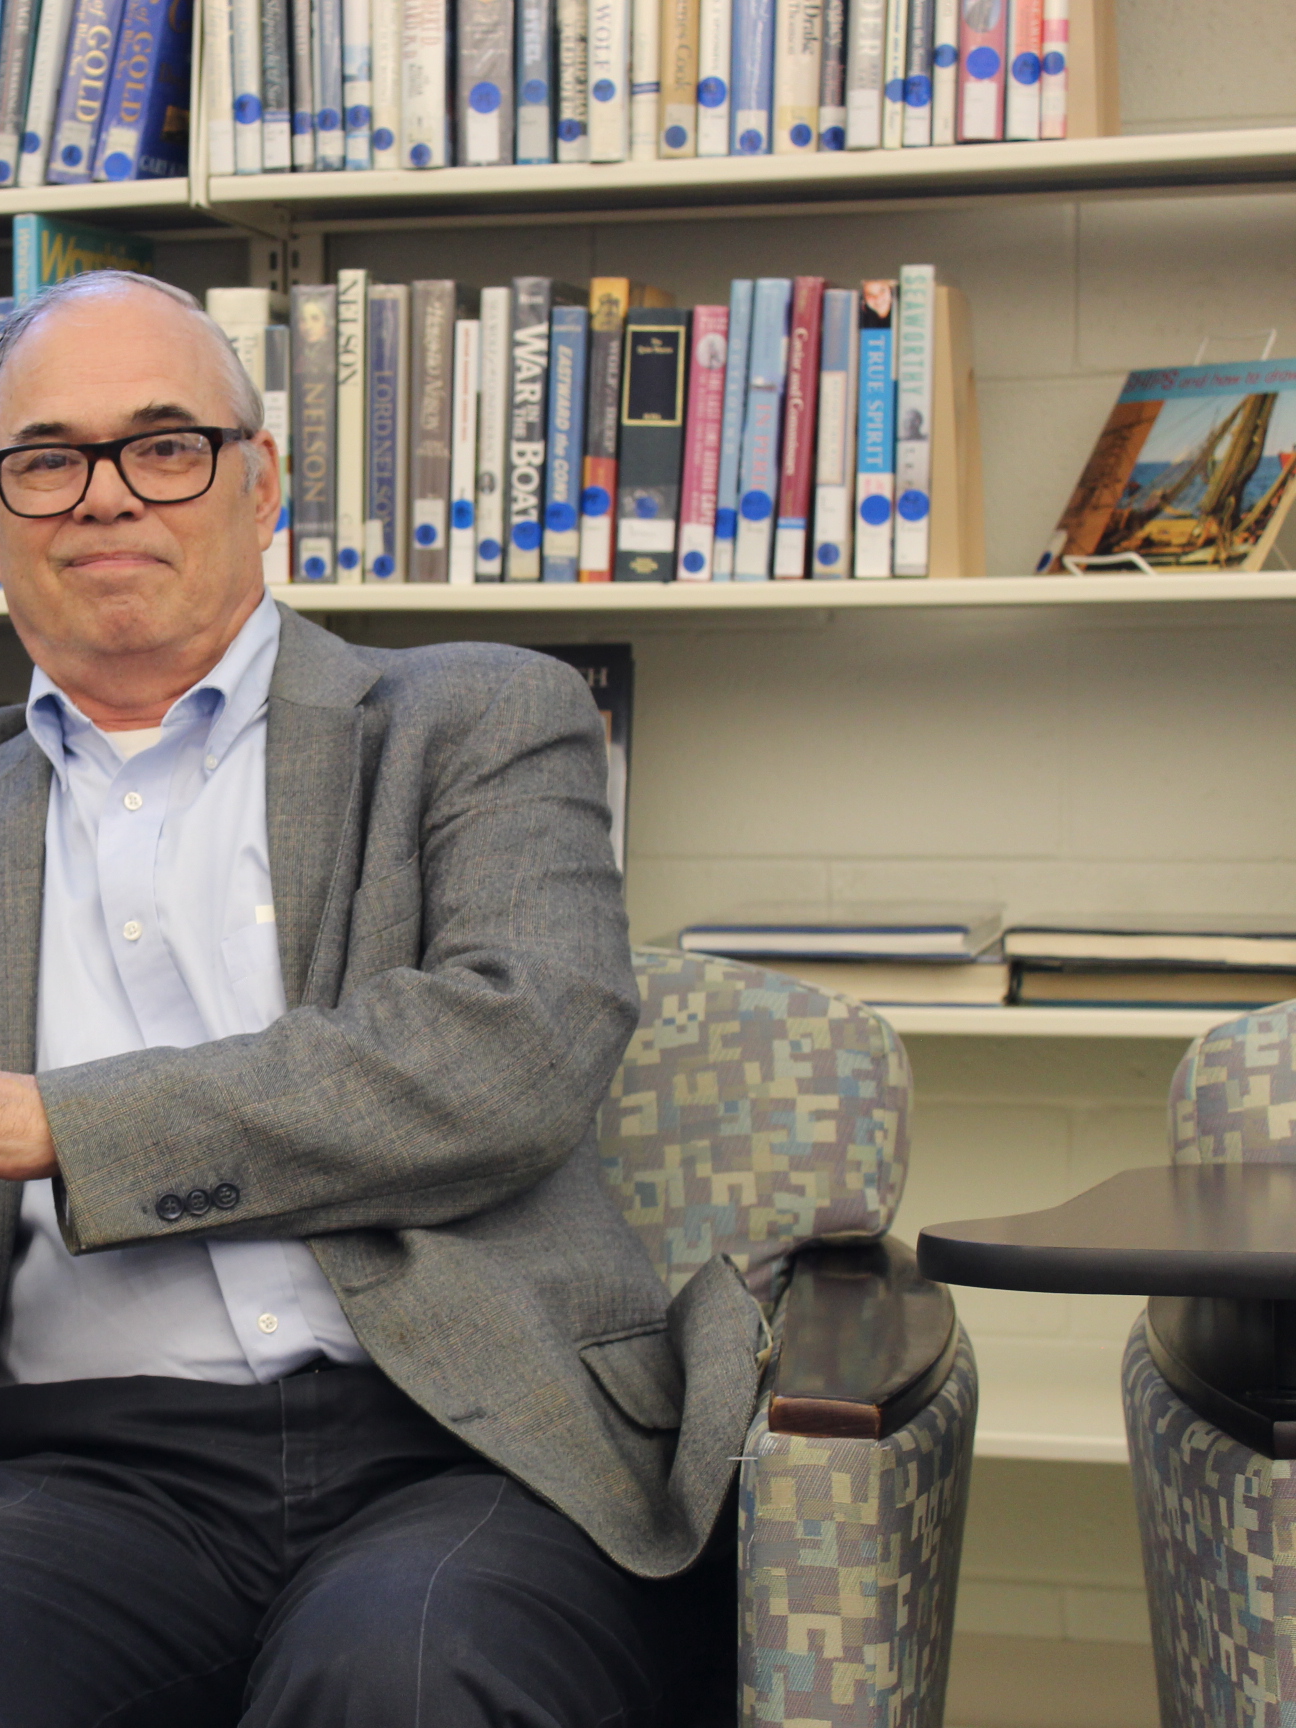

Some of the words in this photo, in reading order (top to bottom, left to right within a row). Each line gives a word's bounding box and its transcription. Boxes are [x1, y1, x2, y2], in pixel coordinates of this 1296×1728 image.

[133, 8, 151, 23] of
[523, 8, 542, 66] STEEL
[593, 4, 611, 72] WOLF
[673, 0, 692, 39] ames
[801, 4, 821, 56] Drake
[68, 54, 82, 77] Sea
[74, 24, 113, 123] GOLD
[119, 31, 154, 123] GOLD
[673, 44, 694, 92] Cook
[338, 278, 360, 387] NELSON
[789, 327, 810, 370] Caviar
[902, 274, 928, 396] SEAWORTHY
[513, 322, 549, 405] WAR
[554, 344, 573, 431] EASTWARD
[607, 339, 620, 387] WOLF
[788, 373, 804, 397] and
[866, 334, 887, 392] TRUE
[1179, 374, 1208, 389] and
[1210, 370, 1242, 386] how
[1245, 370, 1262, 385] to
[373, 370, 394, 437] LORD
[513, 407, 527, 439] THE
[526, 404, 540, 422] IN
[604, 404, 618, 454] DEEP
[755, 404, 773, 428] IN
[302, 382, 326, 502] NELSON
[553, 432, 570, 458] the
[865, 398, 886, 469] SPIRIT
[375, 439, 395, 532] NELSON
[511, 440, 546, 524] BOAT
[552, 459, 570, 503] CONV
[700, 493, 717, 526] CAPE
